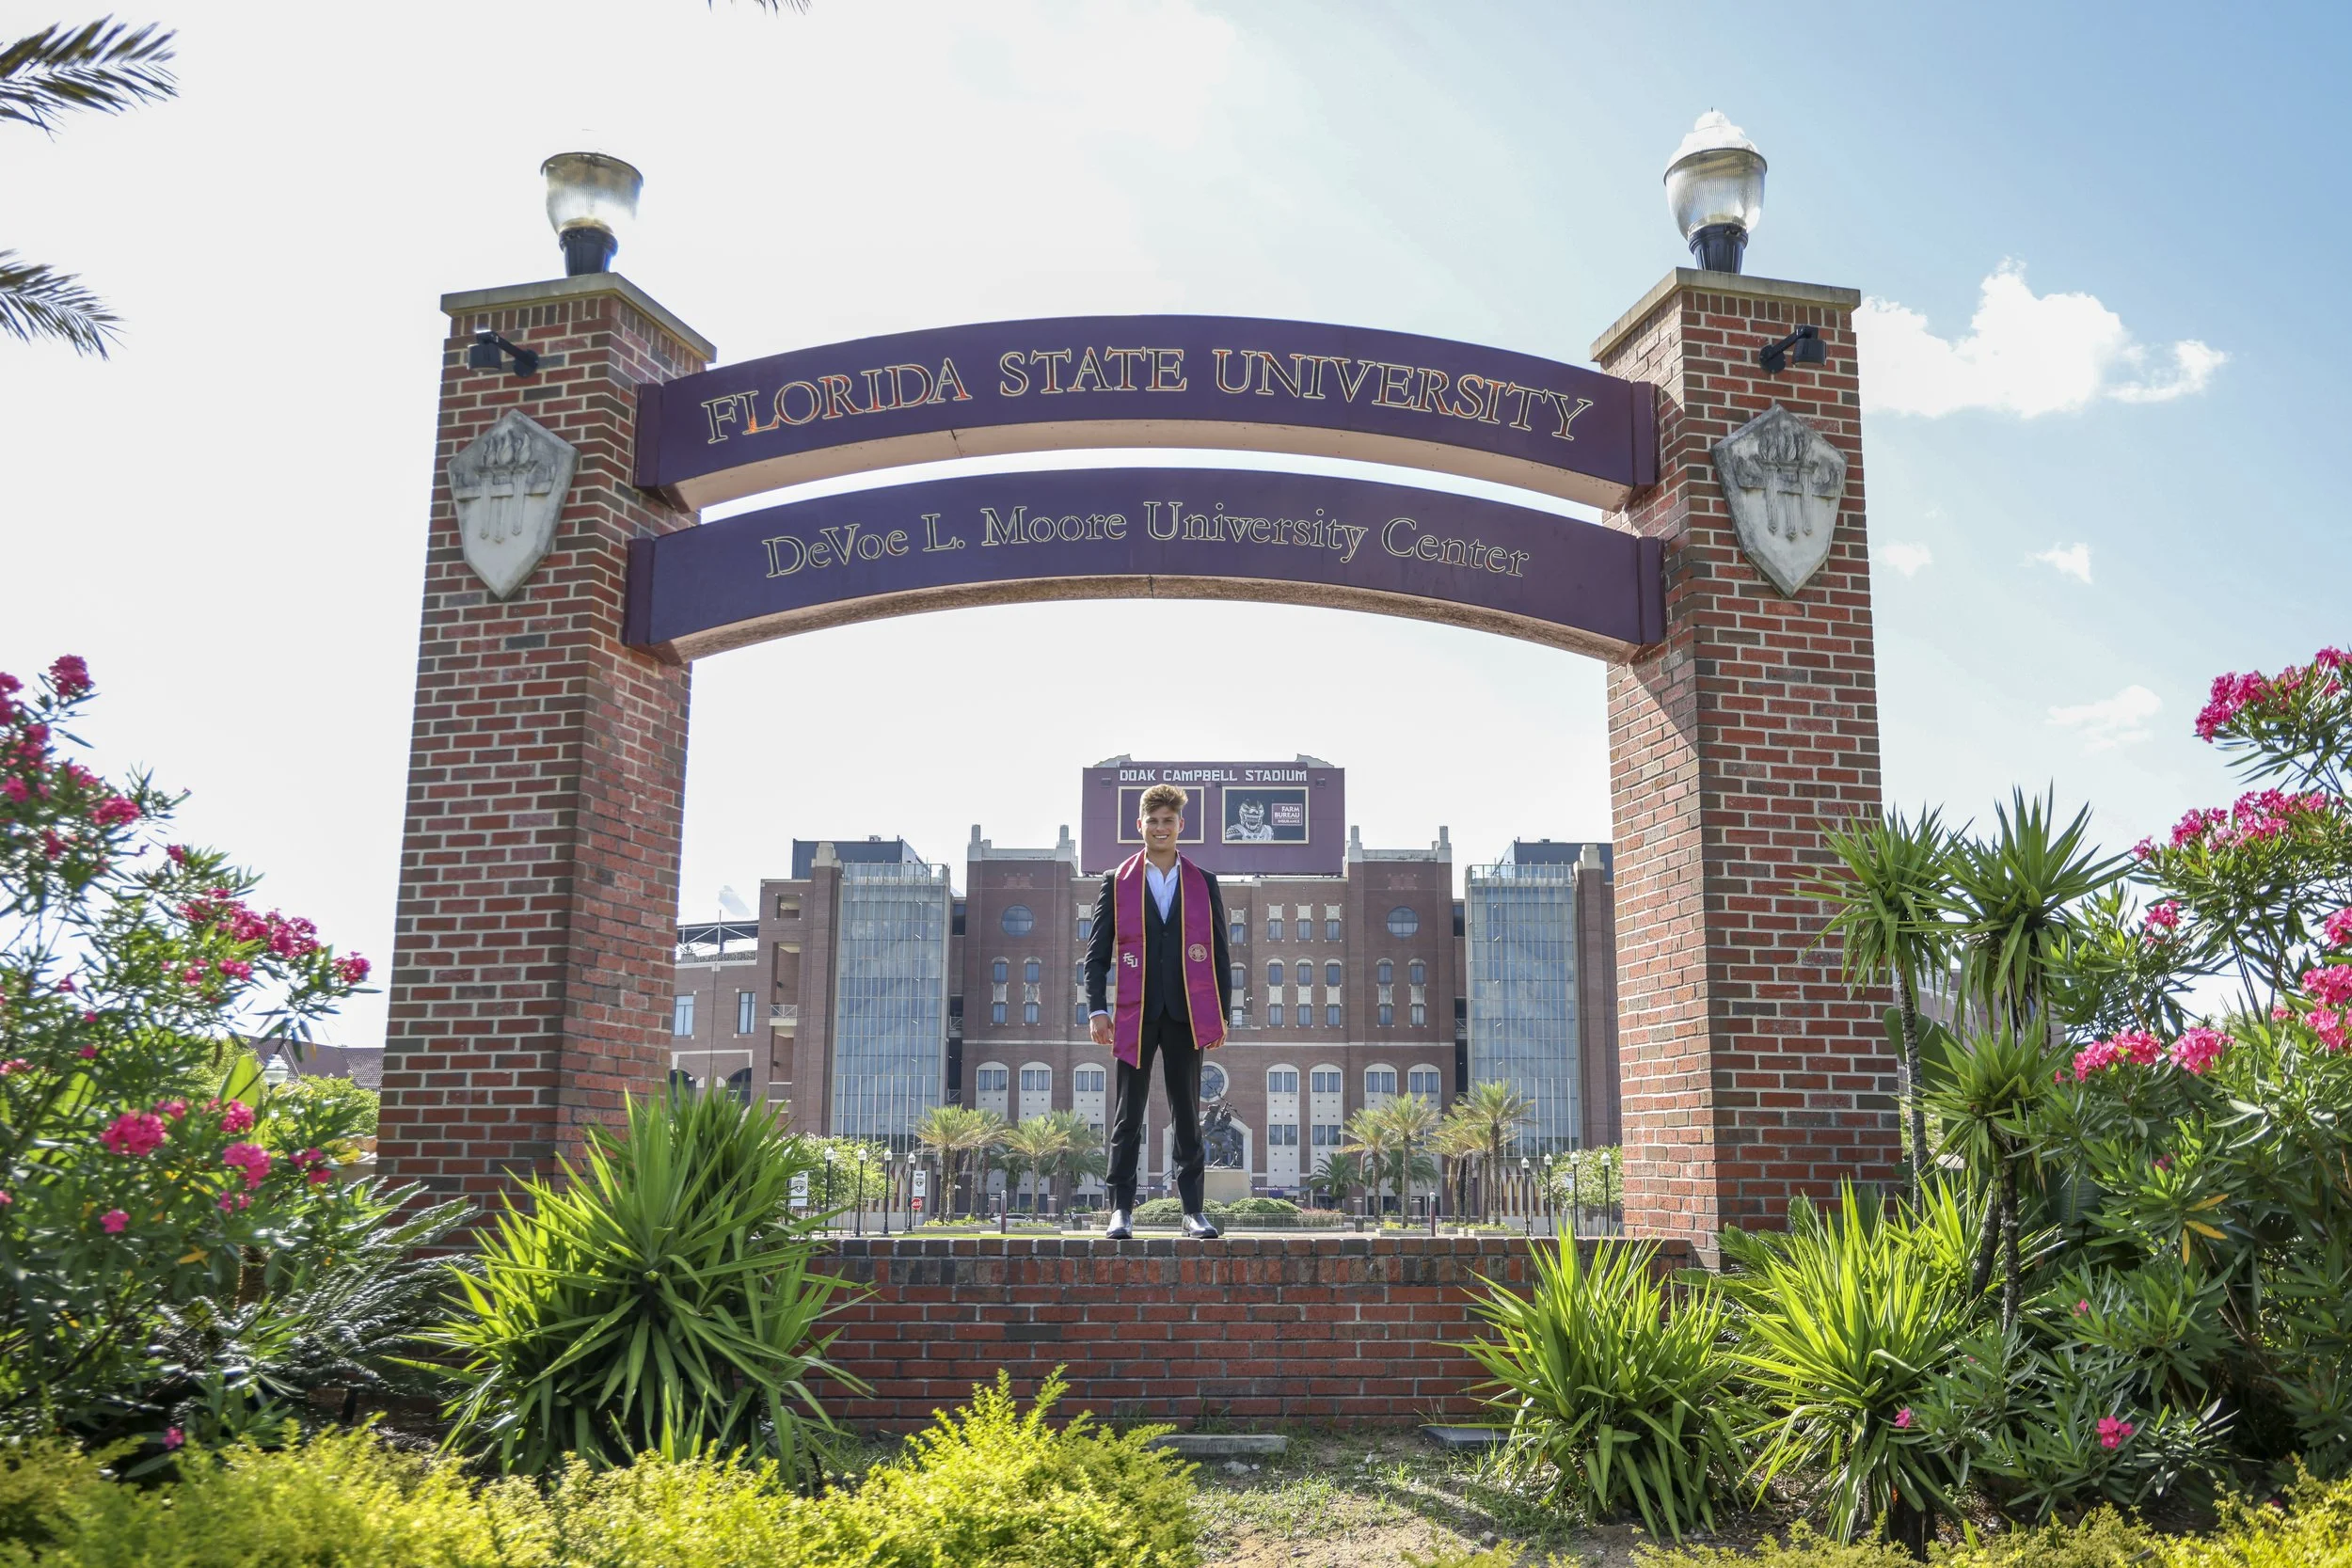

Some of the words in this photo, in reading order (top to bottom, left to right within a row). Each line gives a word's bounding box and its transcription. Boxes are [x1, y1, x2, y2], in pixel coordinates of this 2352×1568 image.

[701, 357, 973, 444] FLORIDA
[999, 346, 1188, 397] STATE
[1212, 349, 1594, 441] UNIVERSITY
[762, 523, 909, 579] DeVoe
[920, 513, 965, 553] L.
[980, 505, 1127, 547] Moore
[1143, 501, 1368, 564] University
[1381, 517, 1530, 578] Center
[1120, 769, 1156, 782] DOAK
[1163, 769, 1238, 782] CAMPBELL
[1245, 769, 1307, 782] STADIUM
[1122, 952, 1138, 968] FSU
